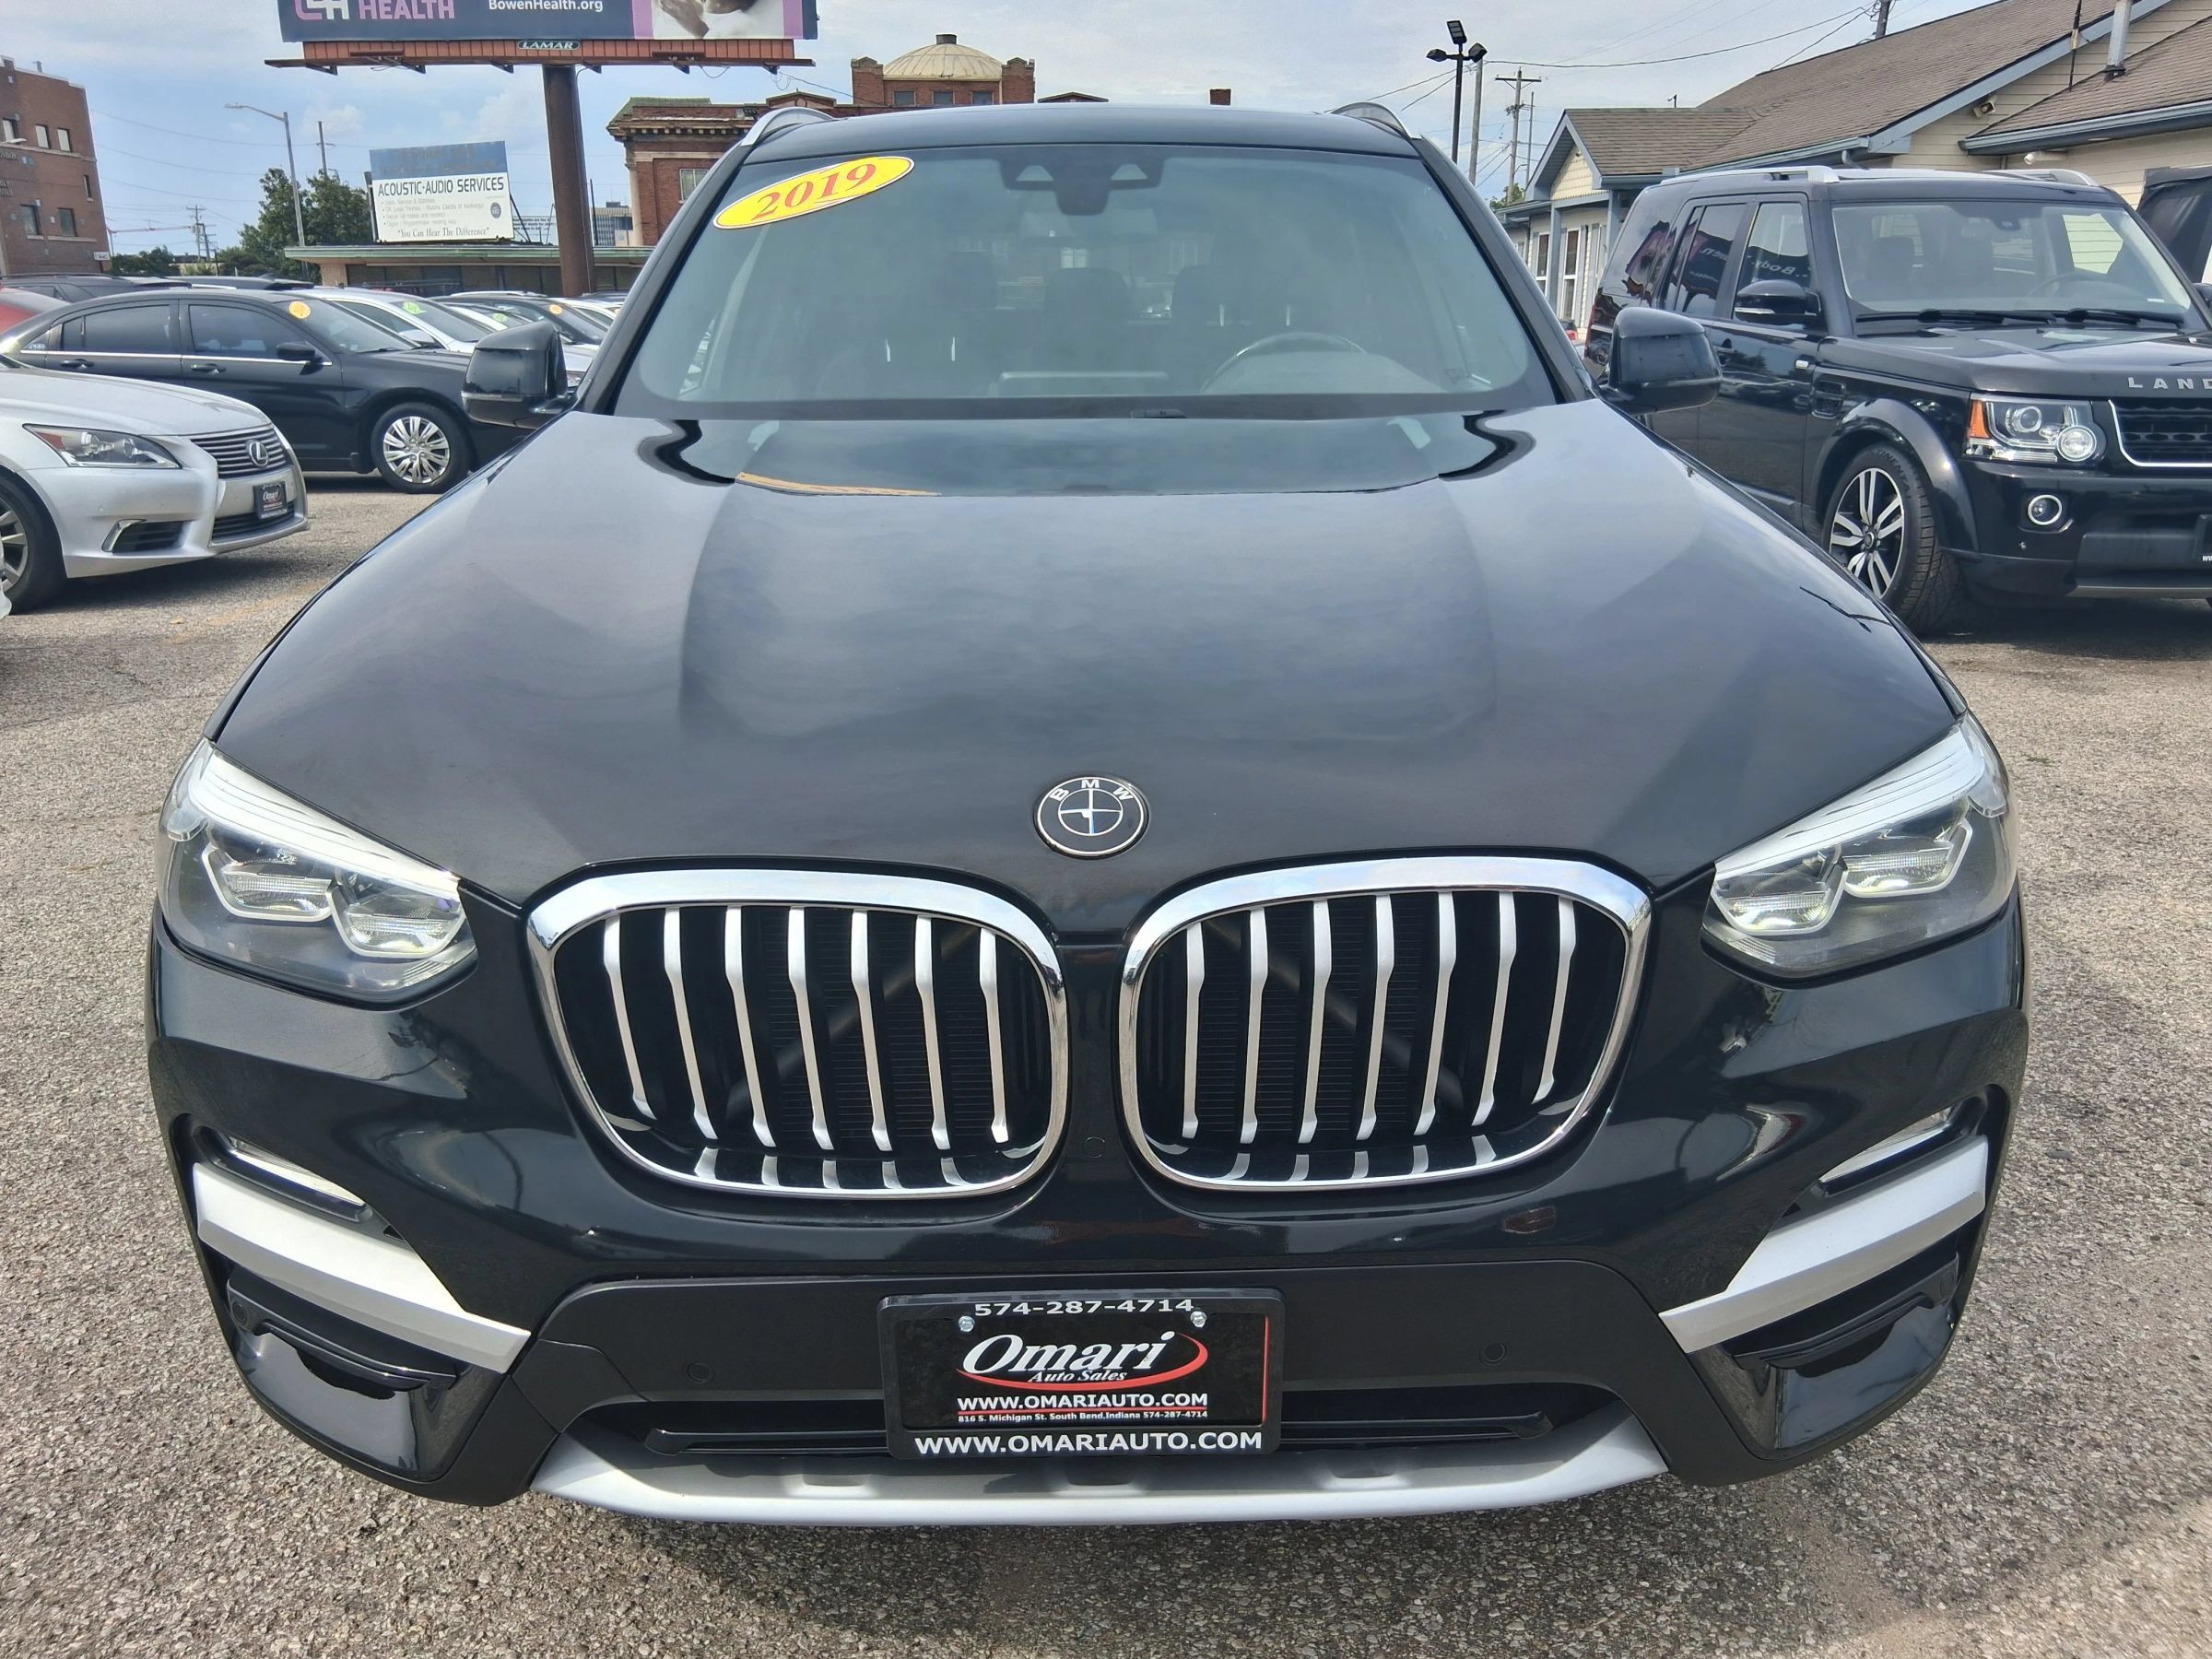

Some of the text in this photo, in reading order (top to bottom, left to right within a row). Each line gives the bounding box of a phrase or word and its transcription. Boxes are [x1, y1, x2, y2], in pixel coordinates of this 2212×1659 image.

[359, 0, 455, 19] HEALTH
[488, 0, 604, 12] BowenHealth.org
[522, 41, 573, 50] LAMAR
[457, 177, 504, 193] SERVICES
[751, 163, 877, 221] 2019
[413, 229, 424, 237] Can
[426, 228, 441, 237] Hear
[442, 227, 454, 236] The
[1049, 779, 1134, 802] BMW
[974, 1299, 1194, 1316] 574-287-4714
[962, 1331, 1176, 1374] Omari
[1028, 1368, 1127, 1382] Auto Sales
[958, 1393, 1208, 1411] WWW.OMARIAUTO.COM
[958, 1415, 975, 1423] 816
[989, 1414, 1032, 1423] Michigan
[1050, 1412, 1077, 1421] South
[915, 1431, 1263, 1455] WWW.OMARIAUTO.COM
